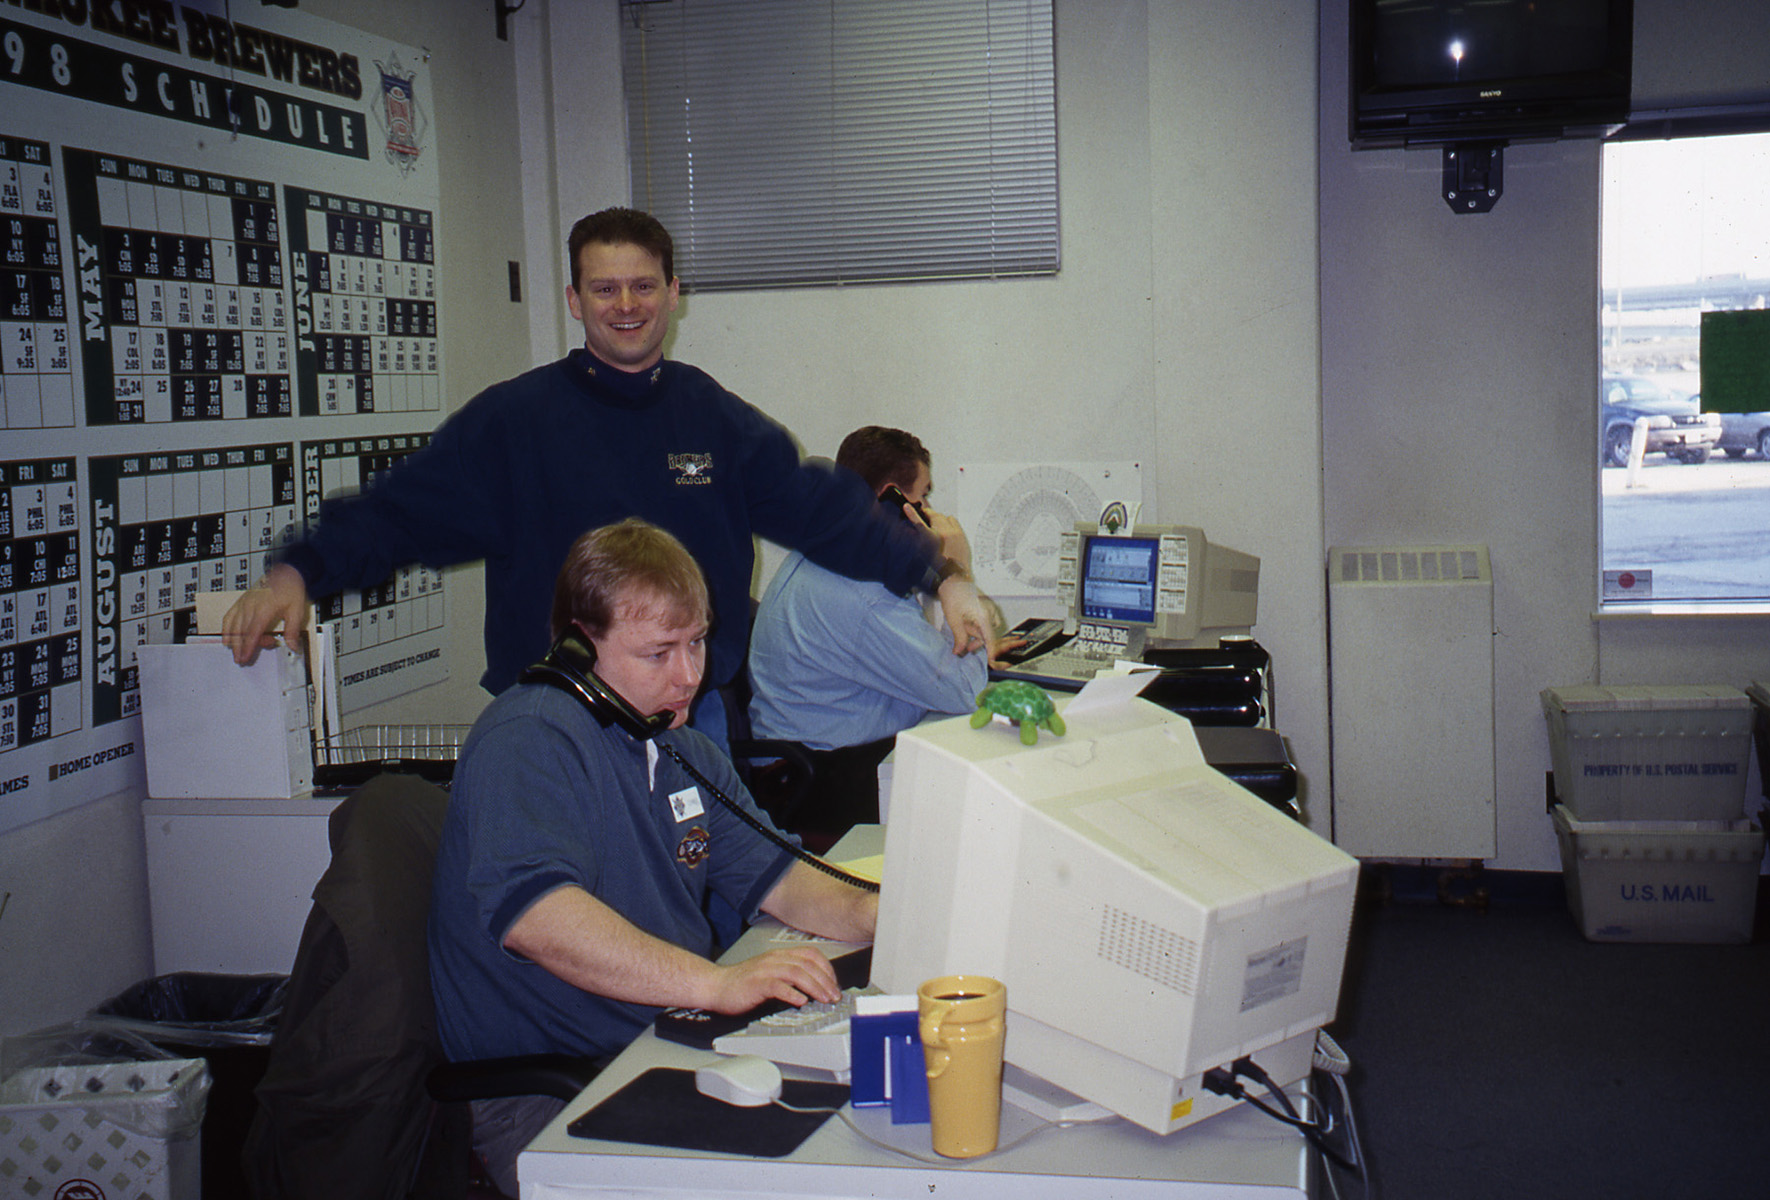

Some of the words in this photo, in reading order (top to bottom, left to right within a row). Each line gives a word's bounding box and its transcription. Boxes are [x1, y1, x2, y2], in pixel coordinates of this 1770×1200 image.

[180, 5, 362, 101] BREWERS
[25, 145, 40, 160] SAT
[101, 159, 117, 174] SUN
[128, 164, 147, 179] MON
[9, 167, 17, 181] 3
[43, 172, 50, 186] 4
[156, 169, 174, 184] TUES
[182, 173, 199, 188] WED
[4, 185, 18, 197] FLA
[207, 178, 226, 192] THUR
[235, 182, 246, 195] FRI
[38, 189, 52, 201] FLA
[258, 186, 269, 199] SAT
[1, 196, 19, 209] 6:05
[36, 200, 53, 213] 6:05
[249, 204, 254, 216] 1
[270, 208, 276, 220] 2
[10, 220, 22, 235] 10
[48, 224, 56, 239] 11
[12, 239, 23, 250] NY
[123, 234, 129, 247] 3
[150, 236, 156, 249] 4
[178, 240, 184, 252] 5
[46, 242, 57, 253] NY
[204, 243, 209, 255] 6
[227, 246, 232, 257] 7
[7, 250, 25, 263] 6:05
[42, 253, 59, 265] 1:05
[273, 251, 278, 263] 9
[15, 274, 26, 289] 17
[50, 276, 61, 290] 18
[77, 234, 105, 341] MAY
[125, 283, 134, 296] 10
[154, 285, 161, 298] 11
[180, 287, 188, 300] 12
[205, 289, 213, 301] 13
[229, 290, 237, 302] 14
[20, 292, 29, 304] SF
[54, 294, 62, 305] SF
[253, 292, 260, 304] 15
[293, 252, 315, 352] JUNE
[12, 304, 30, 316] 6:05
[48, 305, 64, 317] 1:05
[19, 328, 32, 342] 24
[53, 329, 65, 342] 25
[128, 332, 137, 345] 17
[155, 333, 164, 345] 18
[183, 334, 191, 346] 19
[206, 335, 216, 347] 20
[232, 336, 240, 347] 21
[255, 337, 263, 347] 22
[277, 337, 285, 348] 23
[25, 346, 33, 357] SF
[58, 346, 66, 357] SF
[16, 358, 34, 369] 9:35
[51, 358, 68, 369] 3:05
[130, 380, 141, 394] 24
[157, 380, 167, 393] 25
[184, 380, 195, 393] 26
[208, 380, 219, 393] 27
[233, 380, 242, 391] 28
[257, 379, 266, 391] 29
[279, 379, 288, 391] 30
[133, 404, 142, 418] 31
[202, 453, 219, 466] WED
[227, 451, 245, 464] THUR
[254, 450, 265, 461] FRI
[276, 447, 287, 460] SAT
[124, 460, 139, 473] SUN
[150, 457, 168, 471] MON
[176, 455, 194, 468] TUES
[19, 465, 35, 480] FRI
[51, 463, 67, 478] SAT
[36, 489, 43, 503] 3
[67, 486, 74, 499] 4
[1, 493, 9, 507] 2
[27, 507, 44, 518] PHIL
[59, 504, 74, 515] PHIL
[58, 515, 75, 527] 6:05
[217, 518, 223, 530] 5
[242, 515, 247, 527] 6
[265, 512, 271, 524] 7
[27, 519, 44, 531] 6:05
[165, 524, 171, 537] 3
[191, 521, 197, 534] 4
[139, 528, 145, 541] 2
[35, 541, 46, 555] 10
[69, 536, 76, 550] 11
[4, 545, 12, 560] 9
[34, 559, 46, 570] CHI
[65, 554, 77, 565] CHI
[240, 559, 248, 571] 13
[191, 567, 198, 579] 11
[215, 562, 223, 575] 12
[30, 570, 47, 583] 7:05
[139, 576, 145, 588] 9
[162, 571, 171, 584] 10
[68, 587, 77, 600] 18
[95, 499, 115, 686] AUGUST
[3, 599, 14, 613] 16
[37, 592, 47, 607] 17
[66, 604, 77, 615] ATL
[1, 617, 14, 629] ATL
[35, 611, 47, 622] ATL
[64, 616, 78, 628] 6:10
[31, 622, 48, 635] 6:40
[137, 623, 146, 636] 16
[163, 618, 171, 631] 17
[36, 644, 48, 659] 24
[66, 638, 78, 652] 25
[2, 651, 15, 667] 23
[61, 654, 78, 667] MON
[31, 661, 48, 674] MON
[62, 667, 78, 680] 7:05
[343, 671, 365, 687] TIMES
[366, 667, 379, 680] ARE
[380, 659, 406, 675] SUBJECT
[407, 656, 415, 668] TO
[416, 648, 440, 664] CHANGE
[3, 668, 14, 681] NY
[32, 673, 48, 687] 7:05
[38, 695, 49, 709] 31
[2, 704, 14, 719] 30
[2, 722, 14, 735] STL
[32, 726, 49, 738] 7:05
[60, 756, 92, 777] HOME
[93, 743, 135, 766] OPENER
[1584, 764, 1630, 777] PROPERTY
[1632, 765, 1644, 776] OF
[1665, 763, 1698, 777] POSTAL
[1701, 763, 1738, 776] SERVICE
[1620, 884, 1659, 901] U.S.
[1661, 884, 1715, 903] MAIL
